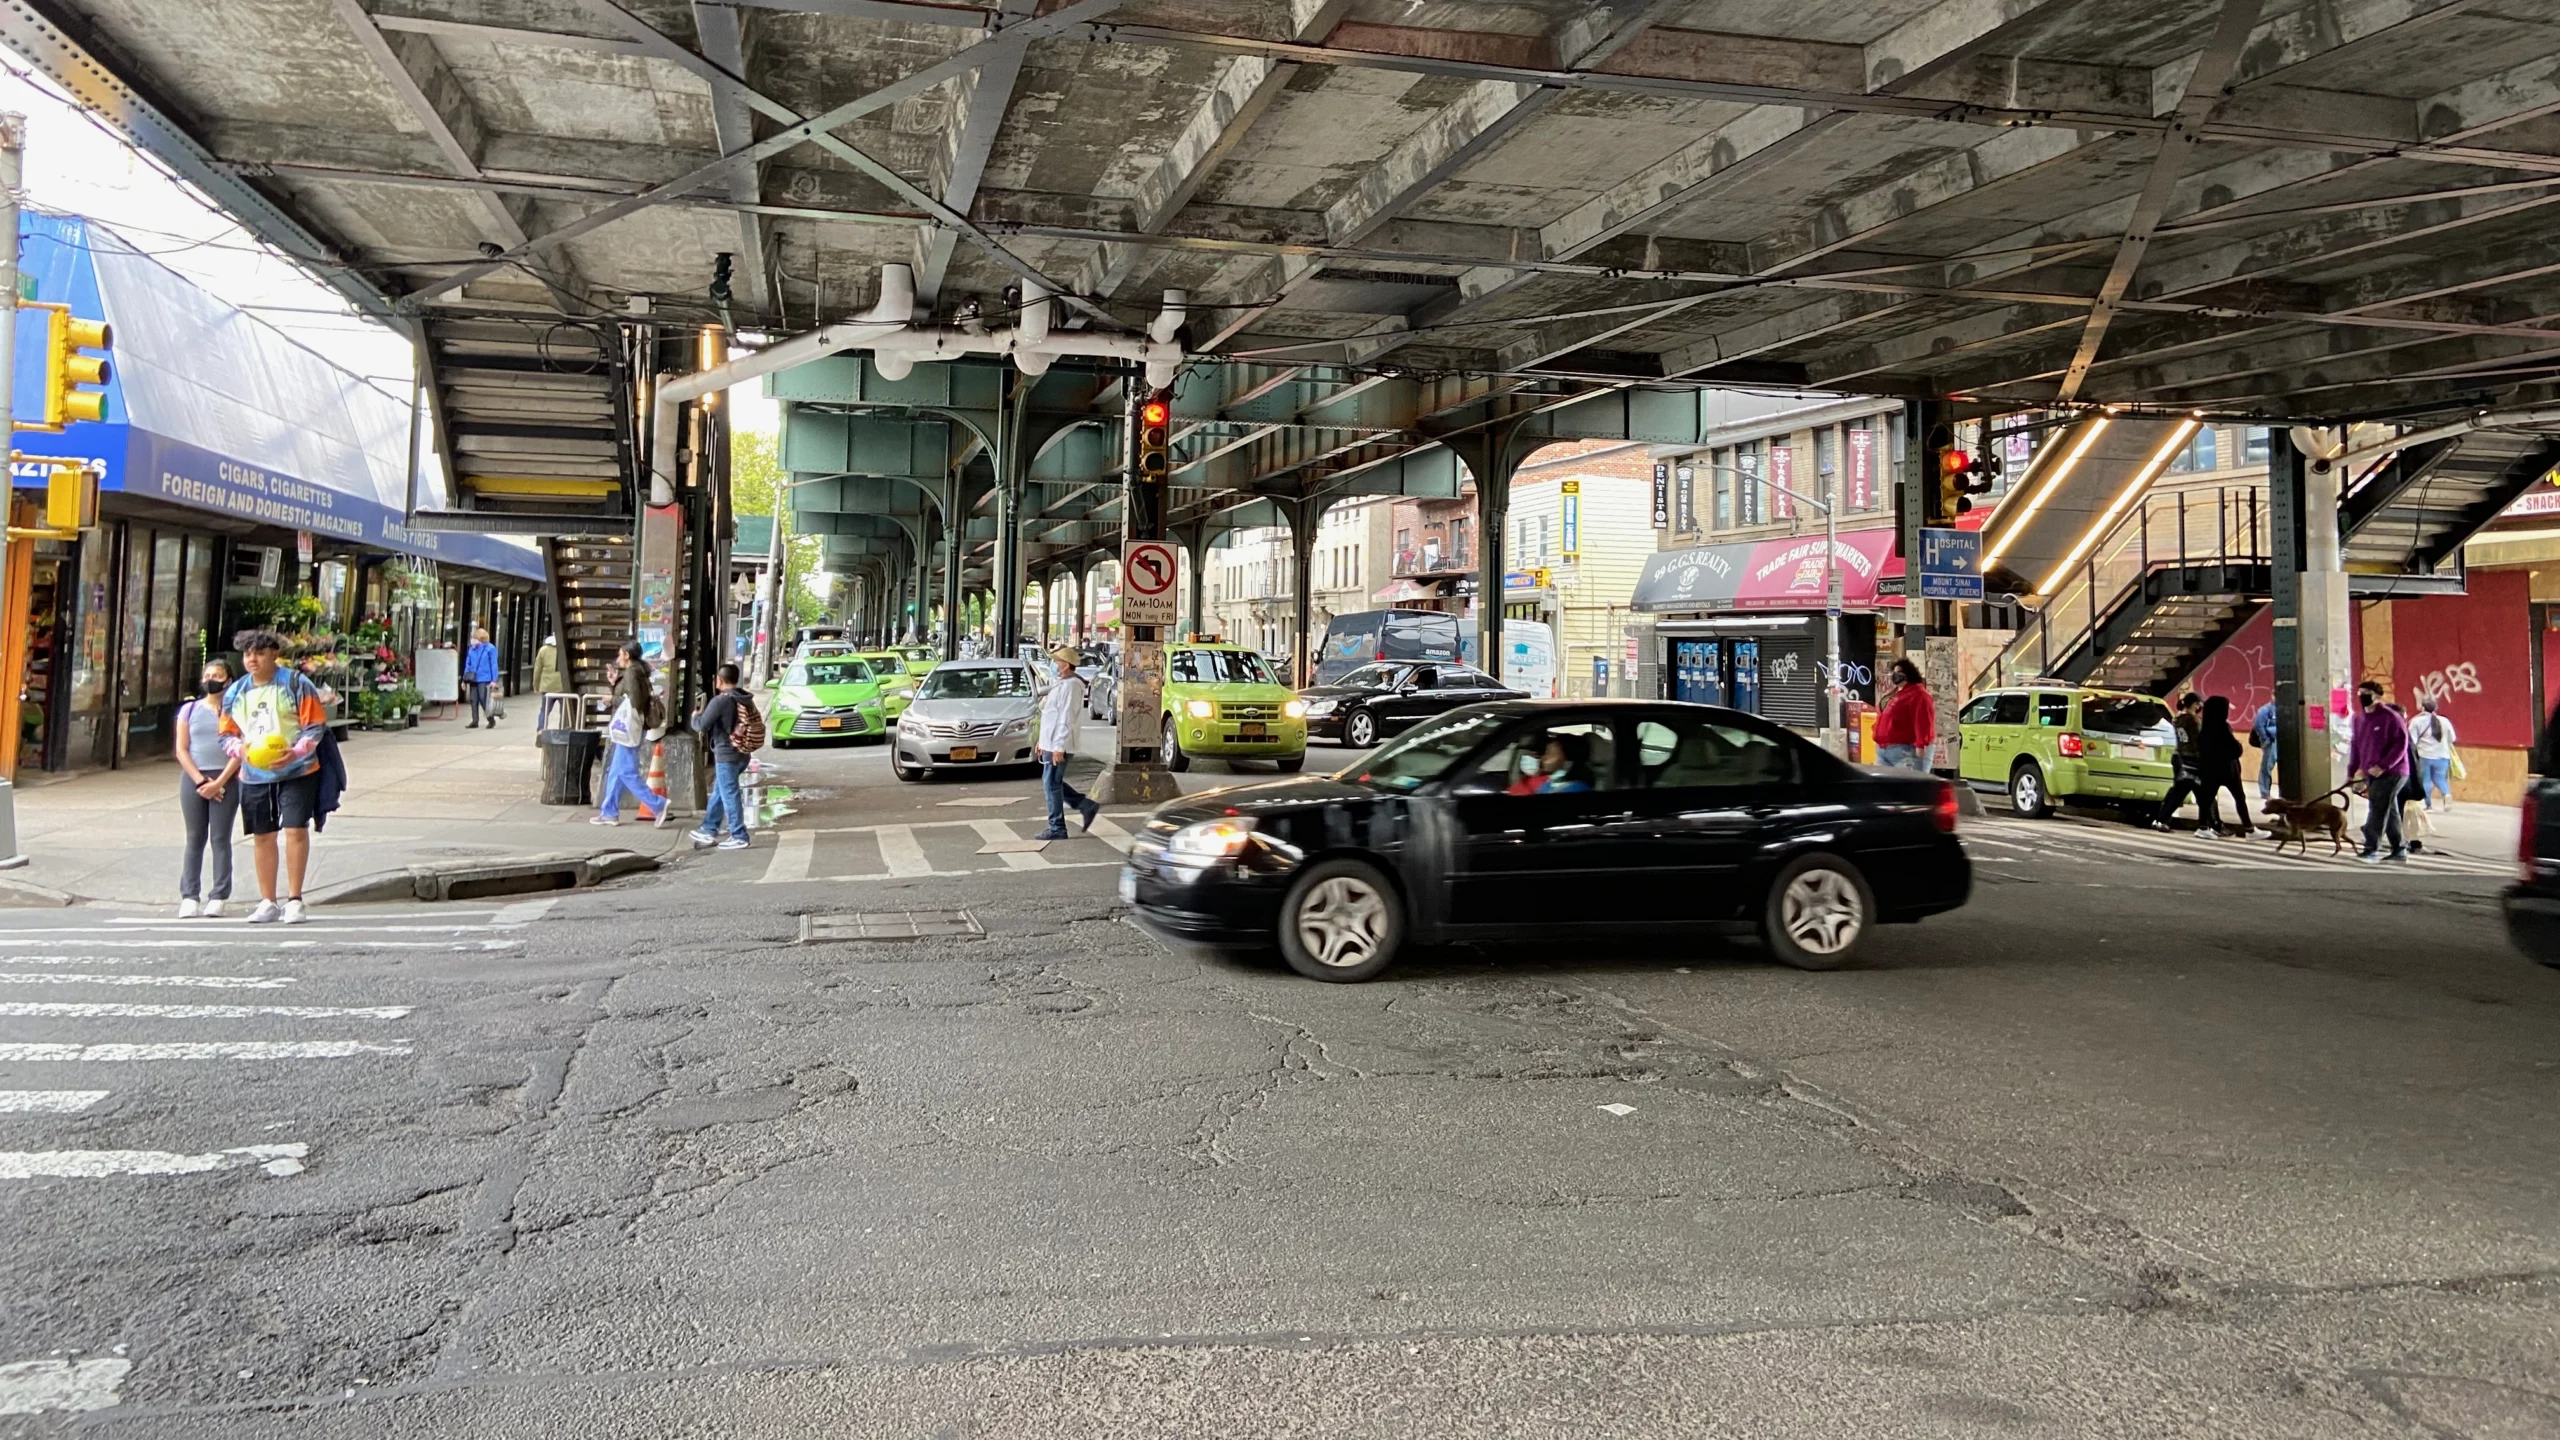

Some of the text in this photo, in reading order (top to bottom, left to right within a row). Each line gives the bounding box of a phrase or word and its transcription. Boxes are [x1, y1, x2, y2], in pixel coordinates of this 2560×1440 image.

[1856, 447, 1865, 479] TRADE
[219, 461, 333, 509] CIGARS, CIGARETTES
[1656, 465, 1665, 510] DENTIST
[1777, 464, 1786, 492] TRAD
[161, 472, 363, 537] FOREIGN AND DOMESTIC MAGAZINES
[1777, 494, 1786, 517] FAIR
[1855, 481, 1864, 506] FAIR
[1755, 540, 1873, 582] TRADE FAIR SUPRMARKETS
[1925, 537, 1975, 566] HOSPITAL
[1695, 551, 1732, 579] REALTY
[1800, 559, 1826, 569] TRADE
[1801, 569, 1819, 578] FAIR
[1879, 582, 1905, 594] Subway
[1923, 586, 1949, 595] HOSPITAL
[1959, 588, 1980, 597] QUEENS
[1932, 577, 1953, 586] MOUNT
[1127, 597, 1173, 609] 7AM-10AM
[1125, 611, 1142, 620] MON
[1161, 613, 1174, 621] FRI
[1425, 648, 1451, 657] amazon
